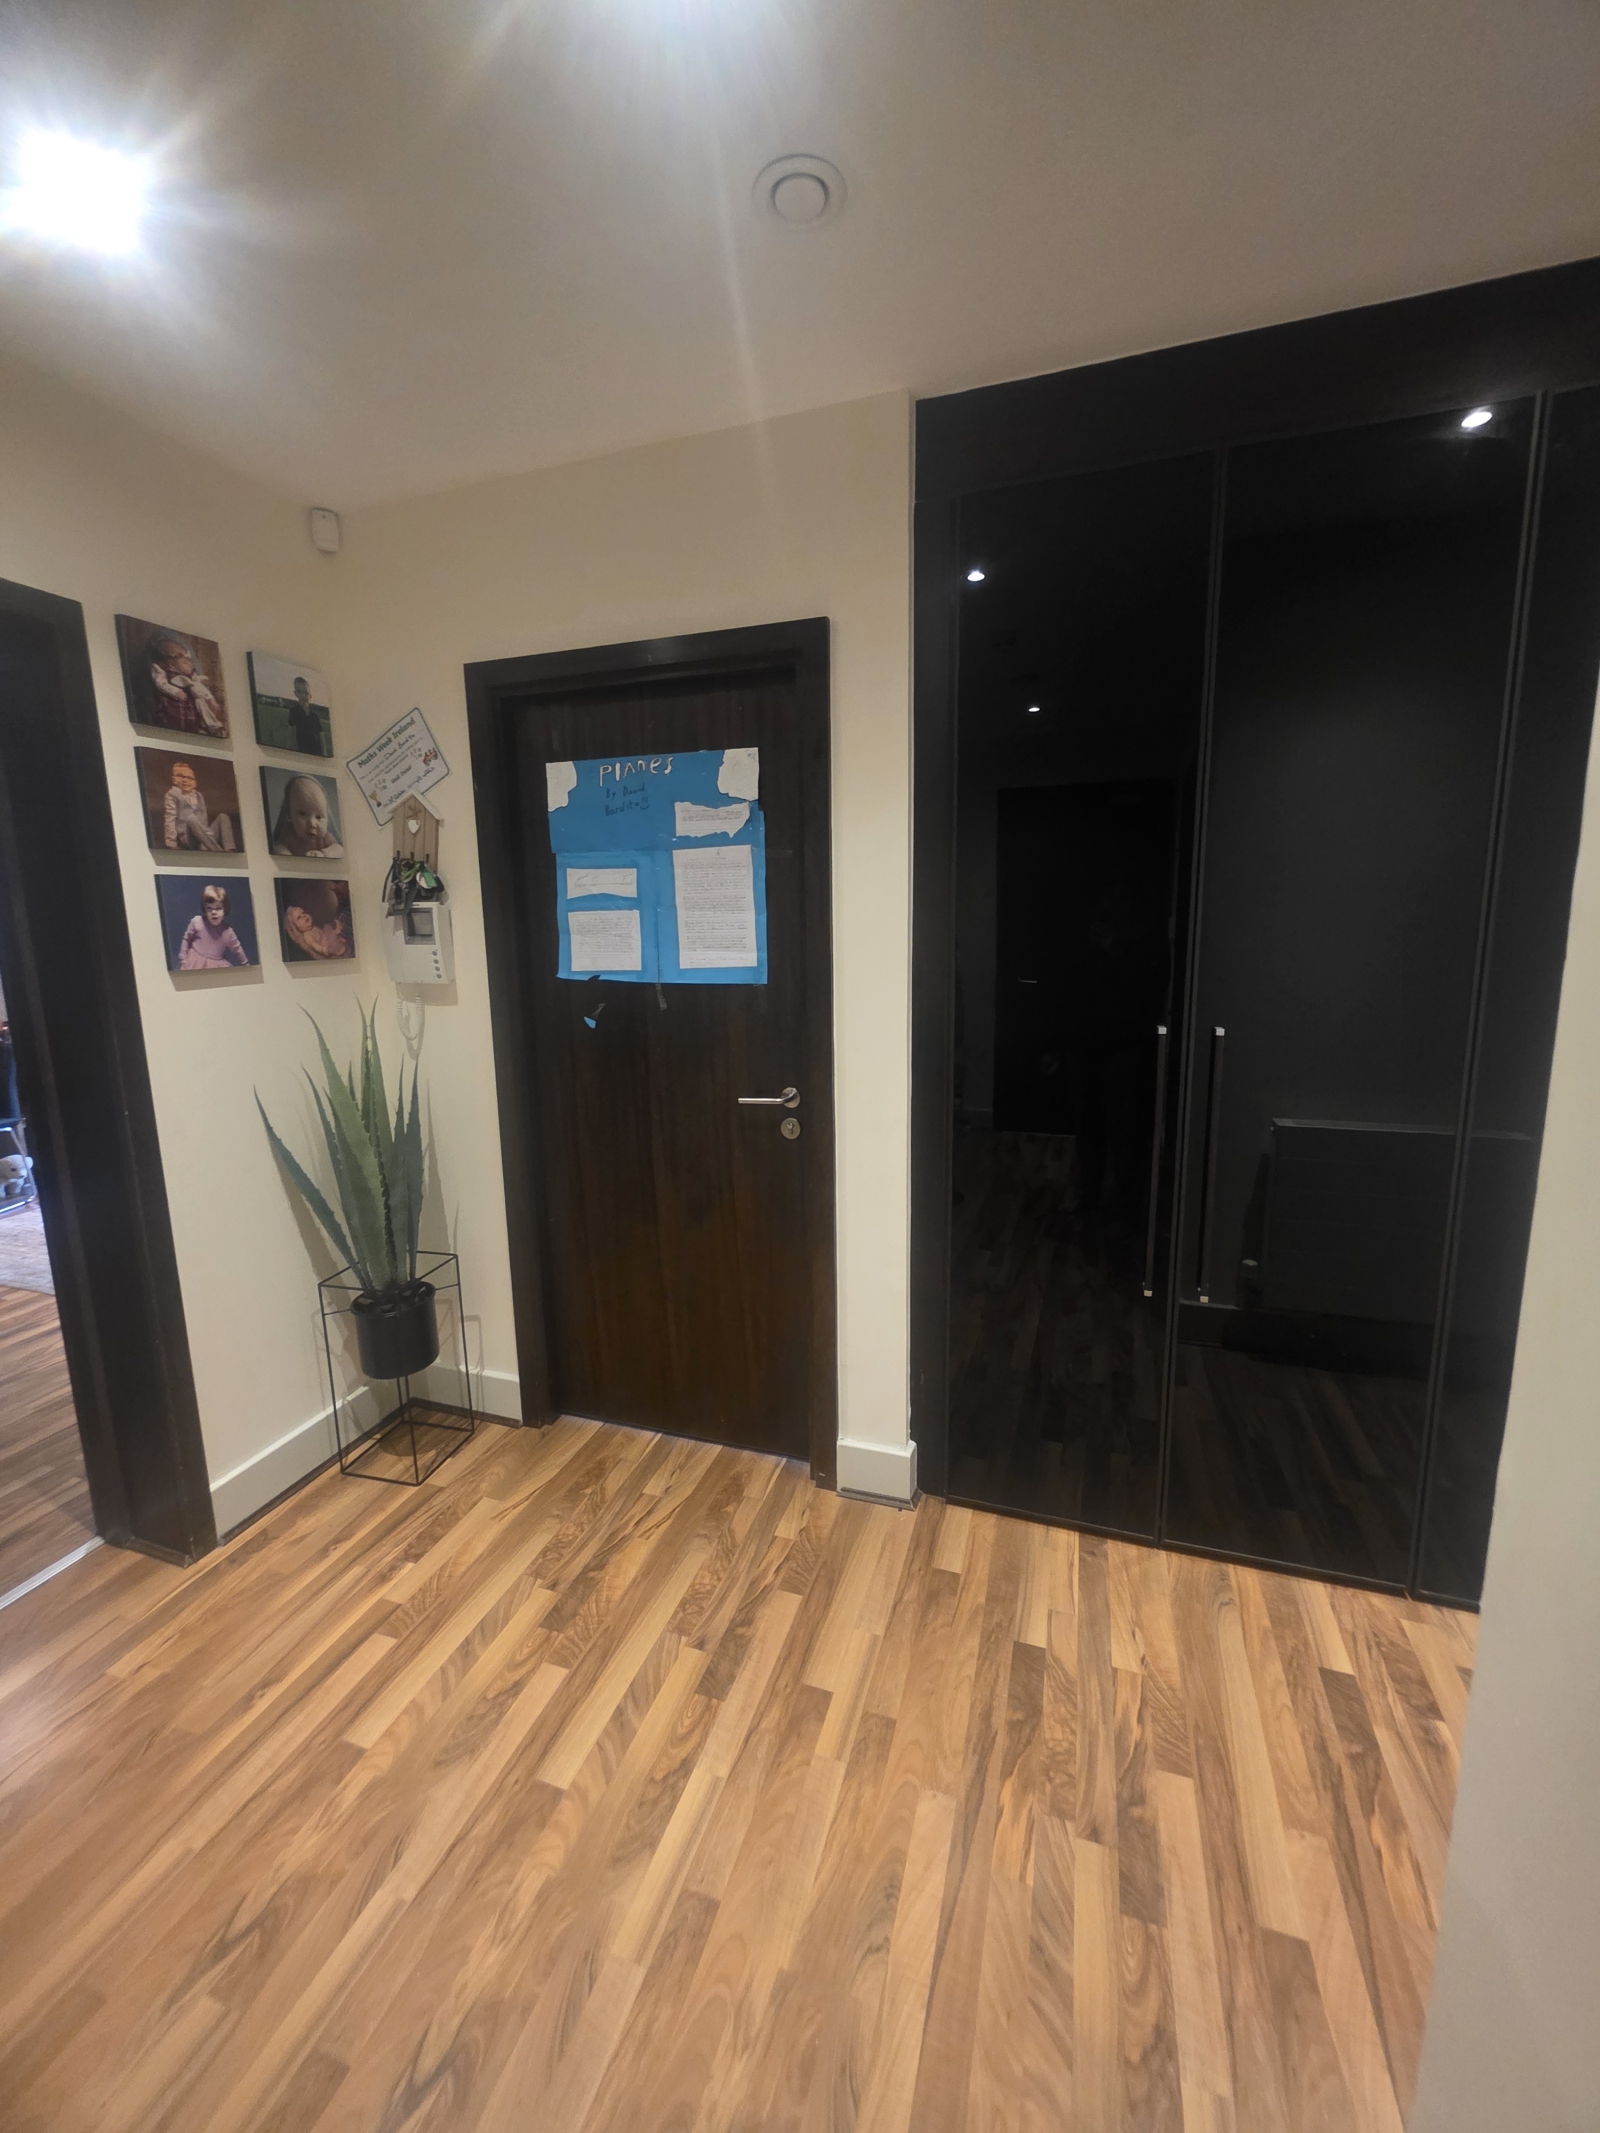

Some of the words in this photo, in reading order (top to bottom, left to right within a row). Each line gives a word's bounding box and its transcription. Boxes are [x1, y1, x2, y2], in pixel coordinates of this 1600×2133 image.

[357, 751, 378, 768] Maths
[376, 736, 393, 753] Week
[392, 717, 416, 740] Ireland
[606, 787, 617, 802] By
[623, 782, 646, 797] David
